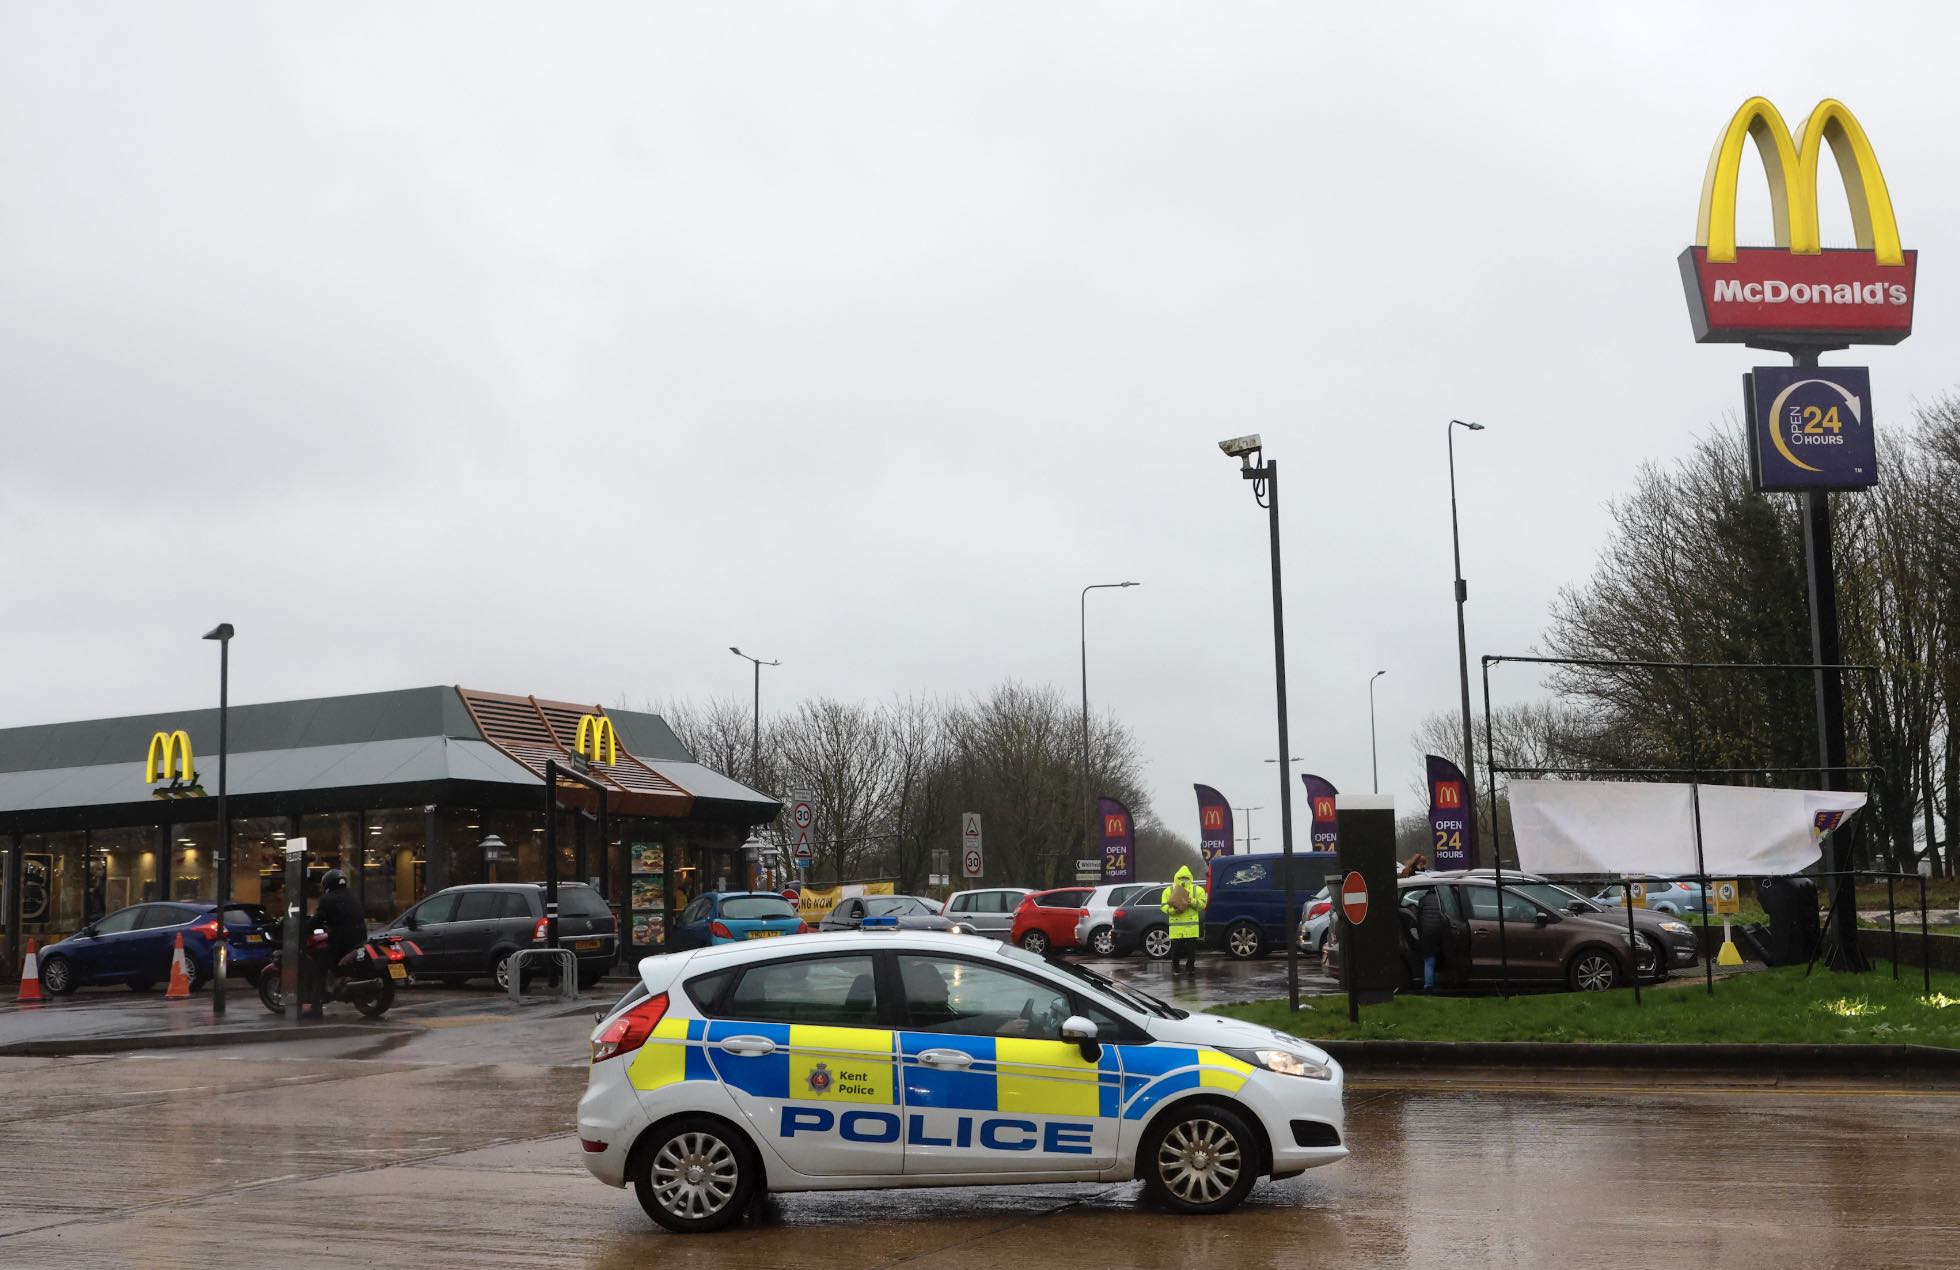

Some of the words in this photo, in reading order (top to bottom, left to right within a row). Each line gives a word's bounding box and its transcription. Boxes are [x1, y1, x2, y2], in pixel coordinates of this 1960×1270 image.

[1713, 279, 1908, 306] McDonald's
[1803, 405, 1842, 434] 24
[1790, 406, 1804, 445] OPEN
[1804, 435, 1844, 445] HOURS
[797, 810, 810, 821] 30
[1435, 820, 1463, 830] OPEN
[1314, 833, 1337, 842] OPEN
[1436, 831, 1462, 850] 24
[1201, 840, 1225, 848] OPEN
[1106, 846, 1127, 854] OPEN
[1436, 850, 1464, 859] HOURS
[967, 857, 979, 867] 30
[1106, 854, 1126, 870] 24
[813, 897, 833, 909] NOW
[839, 1071, 868, 1082] Kent
[839, 1084, 875, 1095] Police
[780, 1105, 1094, 1155] POLICE
